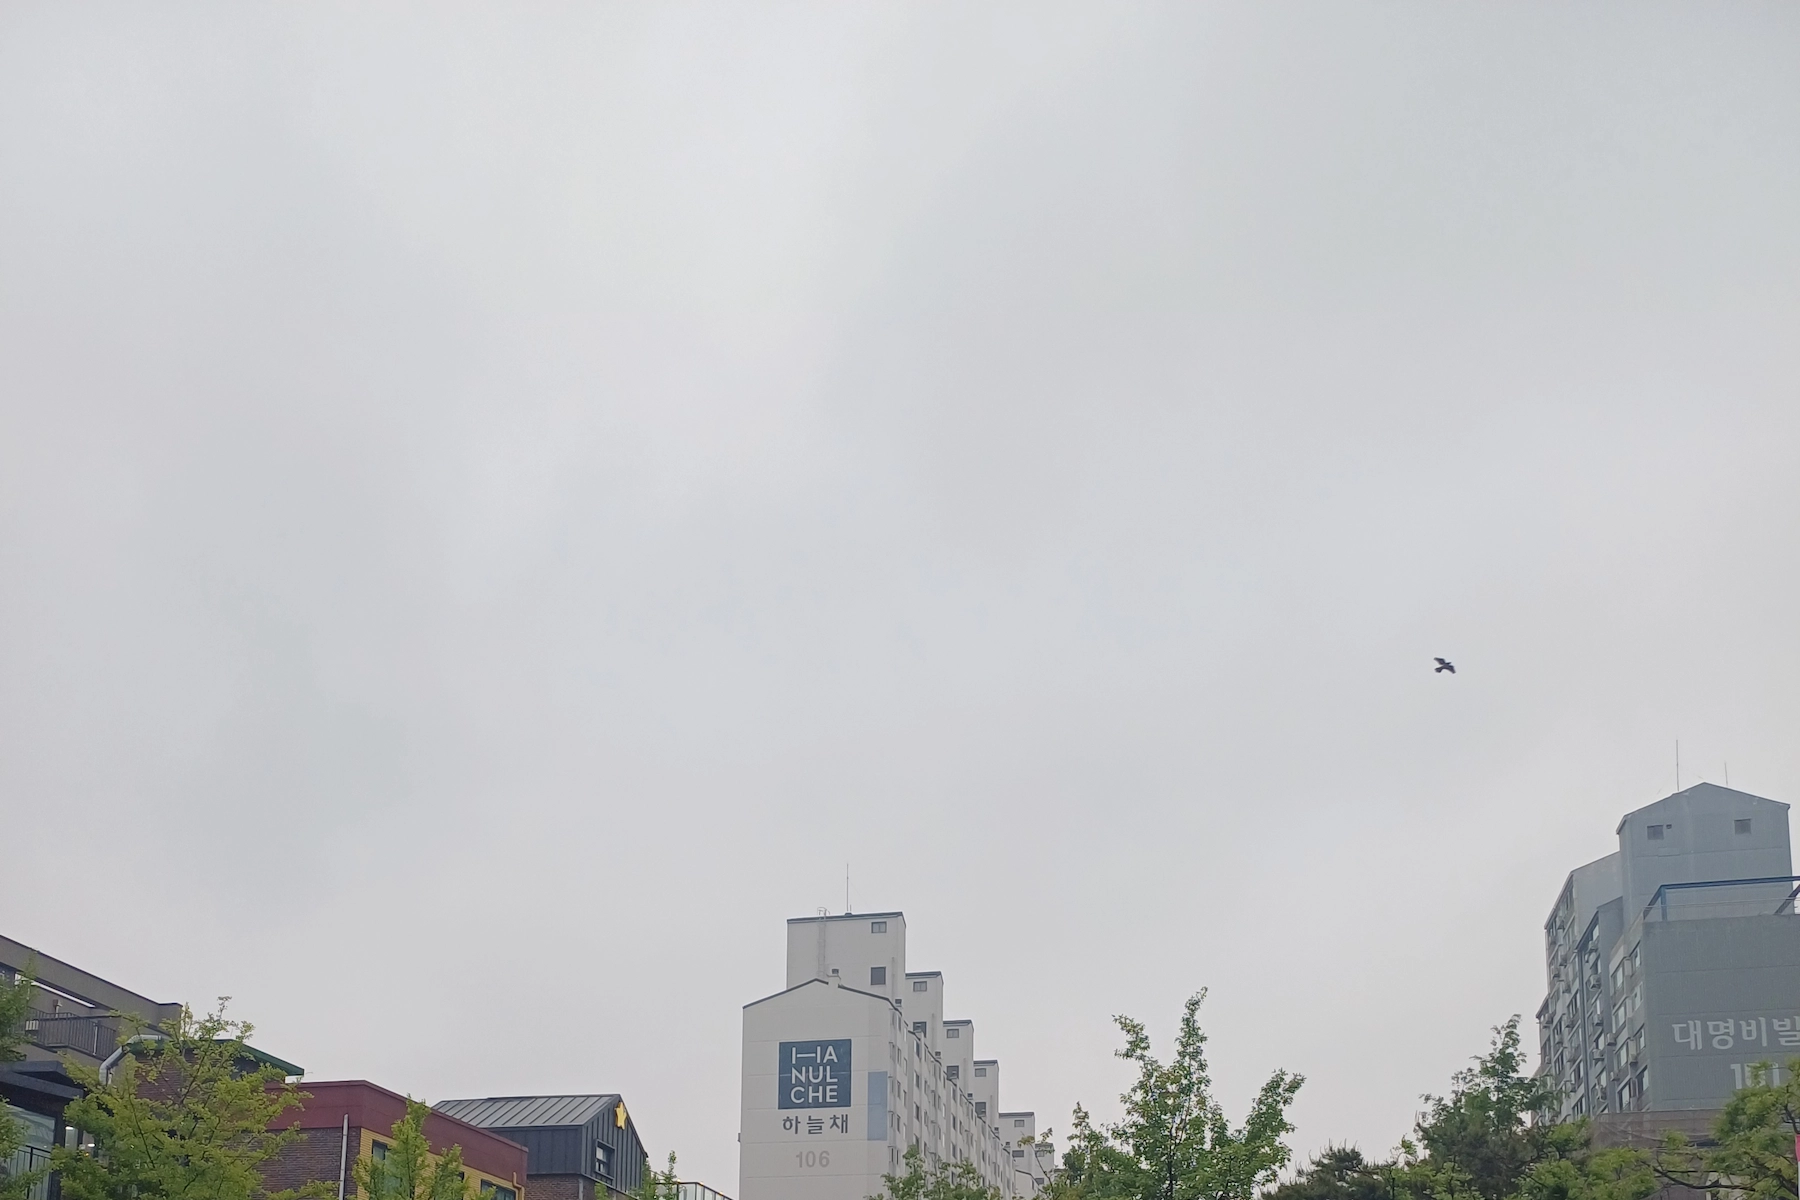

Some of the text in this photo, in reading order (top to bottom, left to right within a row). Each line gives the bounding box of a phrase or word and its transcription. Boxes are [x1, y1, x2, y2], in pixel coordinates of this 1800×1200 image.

[791, 1065, 838, 1084] NUL
[790, 1085, 838, 1104] CHE
[782, 1113, 849, 1135] 하늘채
[795, 1150, 830, 1168] 106
